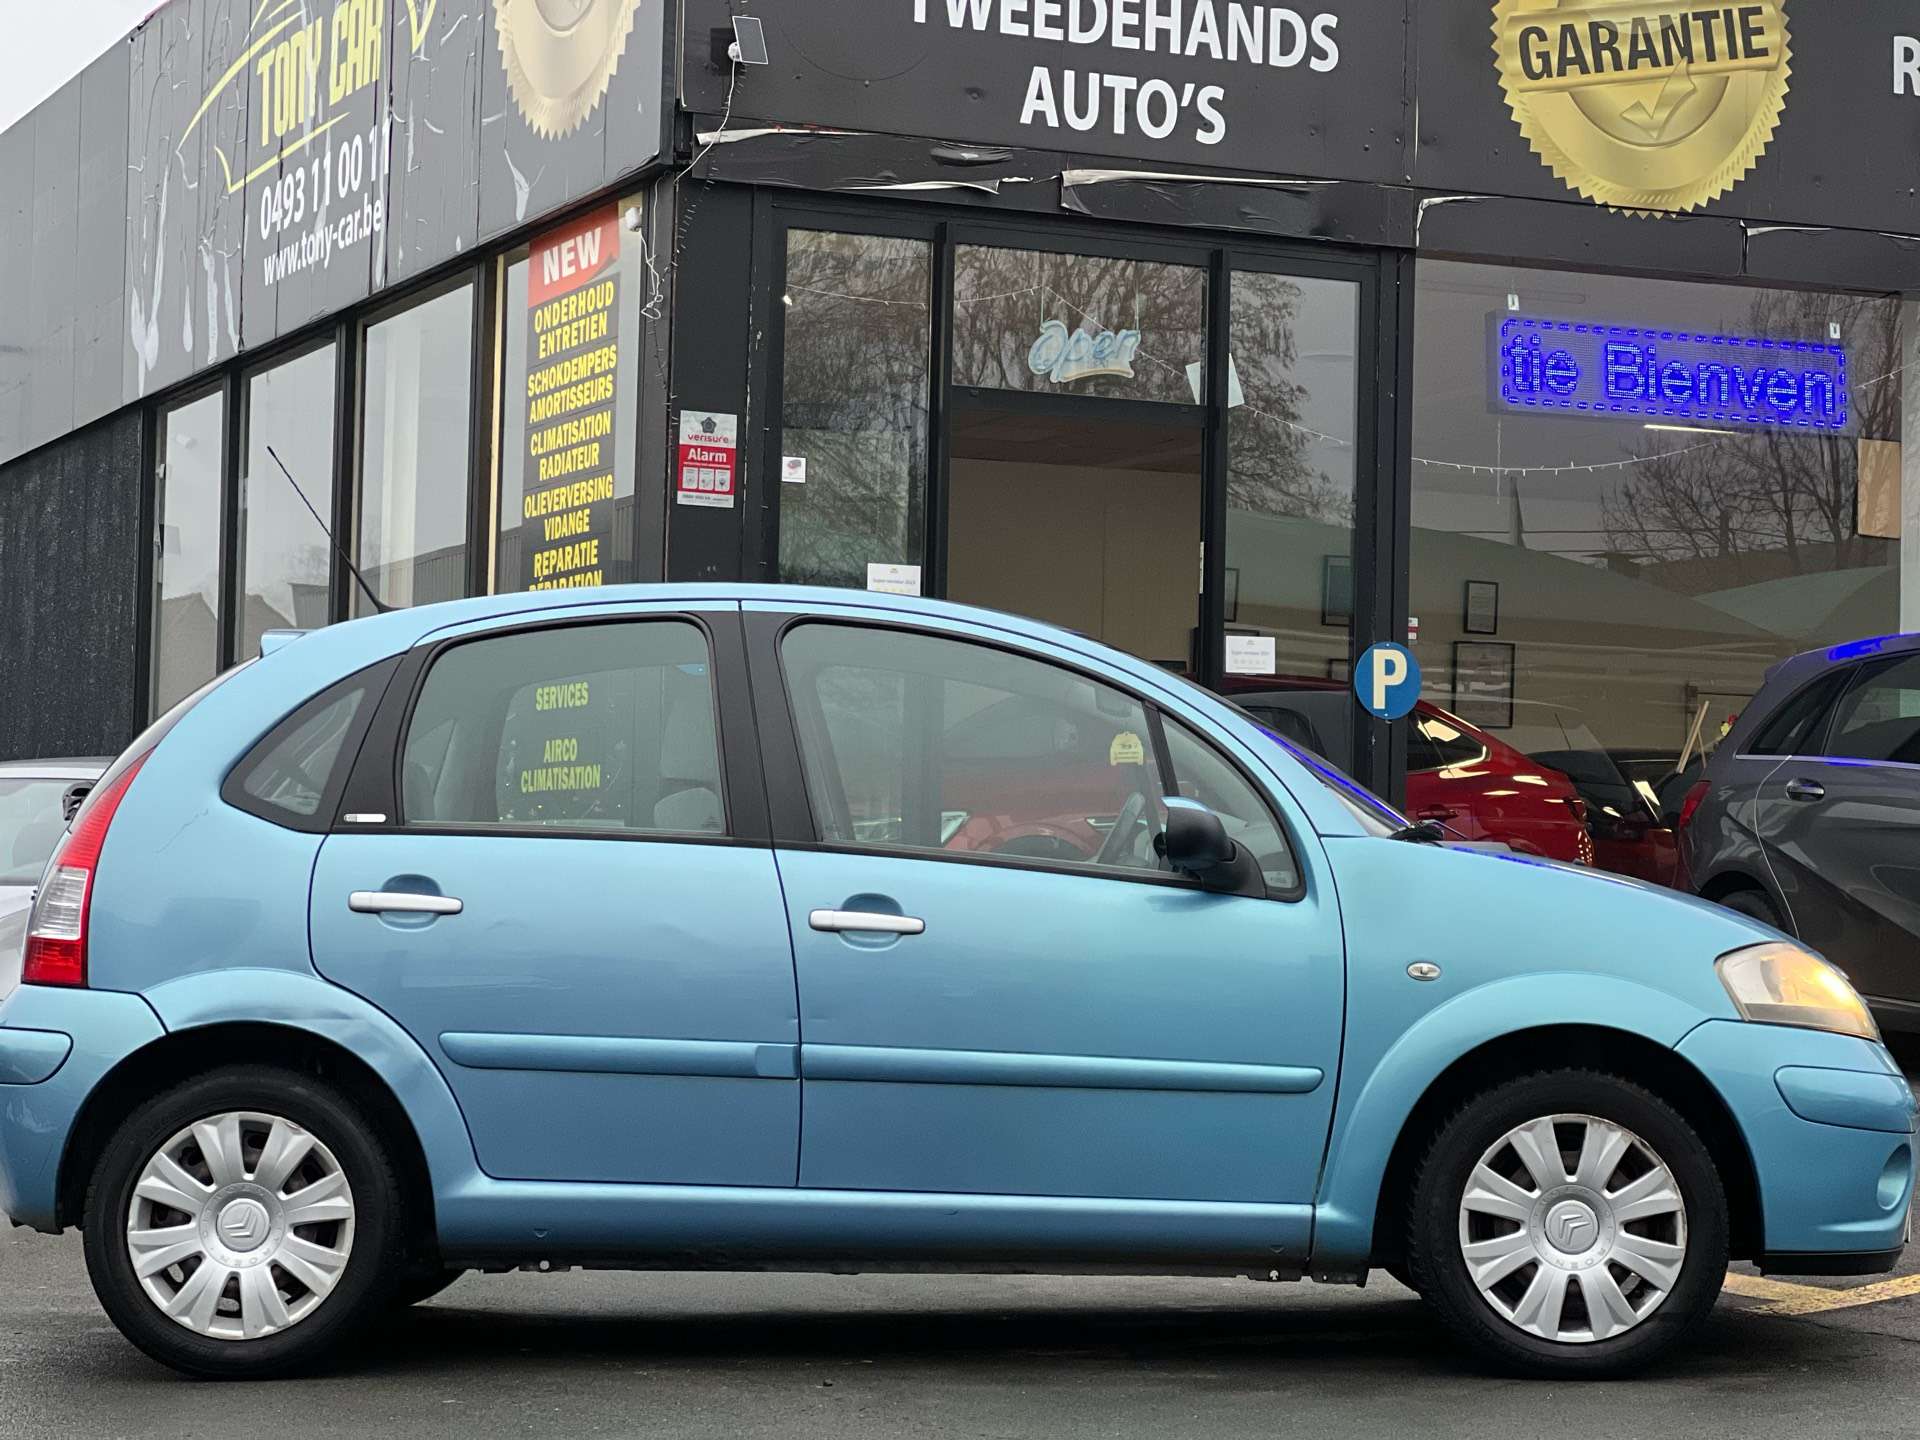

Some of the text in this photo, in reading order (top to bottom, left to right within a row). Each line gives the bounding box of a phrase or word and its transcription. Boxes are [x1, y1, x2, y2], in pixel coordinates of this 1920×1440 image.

[1518, 6, 1769, 80] GARANTIE
[256, 0, 384, 147] TONY CAR
[261, 116, 391, 240] 0493 11 00 11
[263, 192, 382, 286] www.tony-car.be
[543, 227, 603, 286] NEW
[534, 281, 614, 333] ONDERHOUD
[539, 311, 608, 359] ENTRETIEN
[527, 344, 617, 397] SCHOKDEMPERS
[529, 374, 613, 424] AMORTISSEURS
[530, 411, 612, 456] CLIMATISATION
[687, 433, 729, 444] verisure
[687, 447, 727, 463] Alarm
[539, 442, 600, 481] RADIATEUR
[524, 474, 614, 518] OLIEVERVERSING
[544, 508, 591, 541] VIDANGE
[534, 539, 599, 578] REPARATIE
[535, 681, 589, 711] SERVICES
[1374, 649, 1407, 709] P
[543, 738, 577, 763] AIRCO
[521, 764, 601, 793] CLIMATISATION
